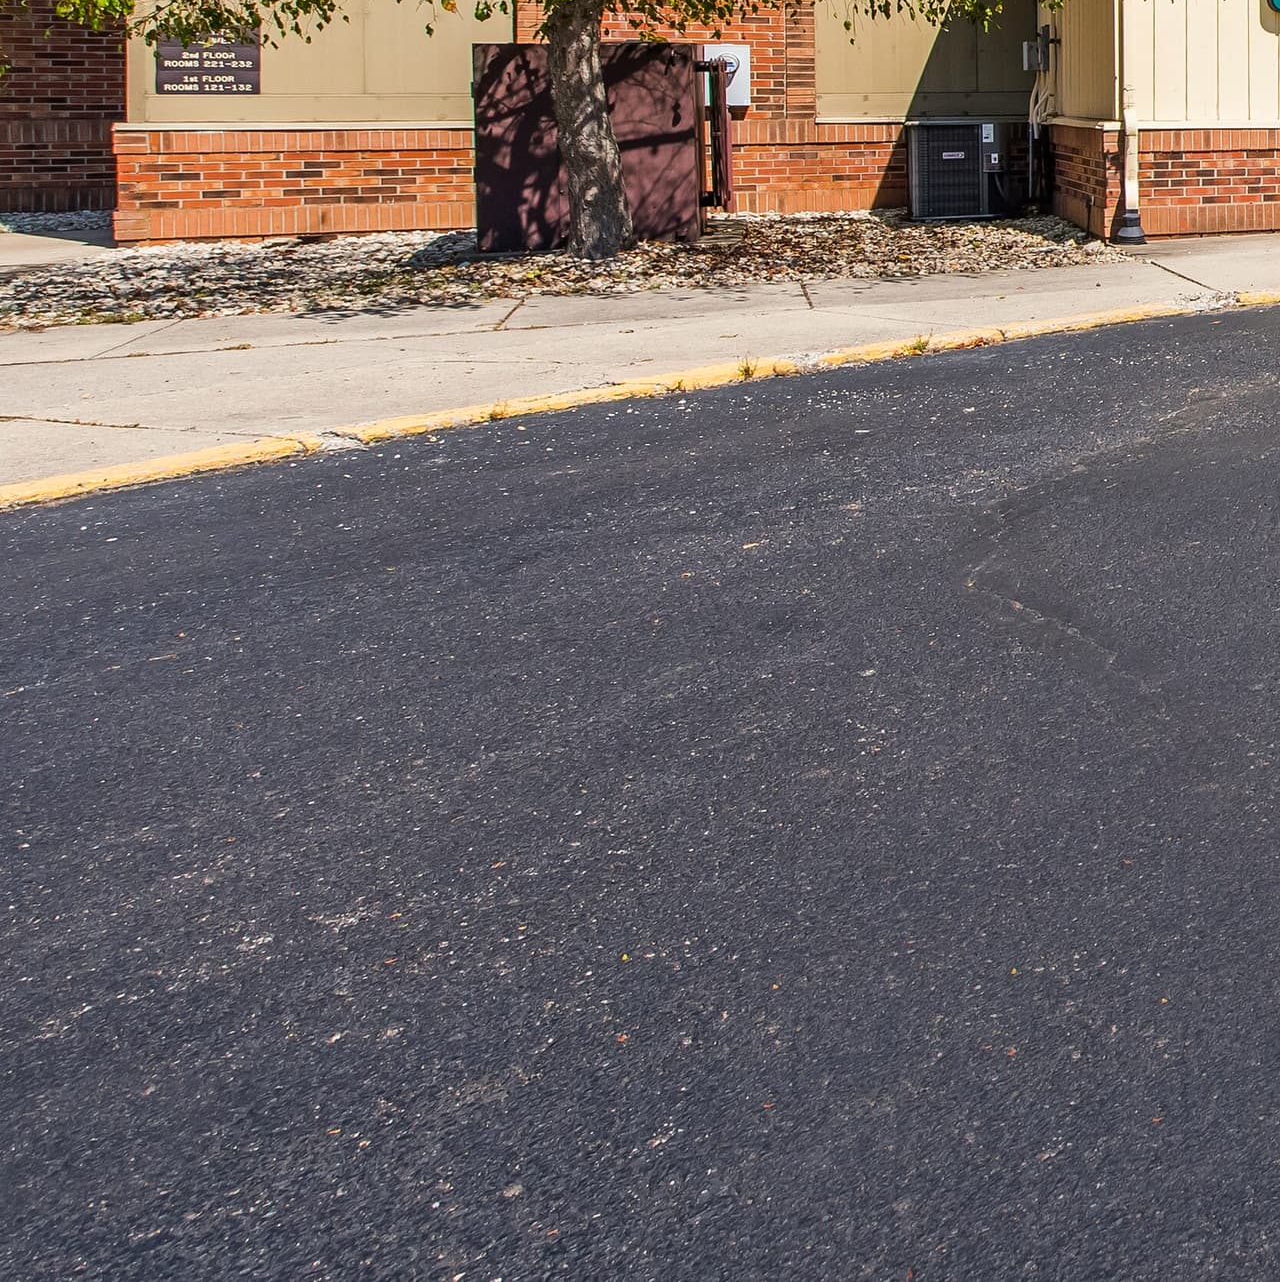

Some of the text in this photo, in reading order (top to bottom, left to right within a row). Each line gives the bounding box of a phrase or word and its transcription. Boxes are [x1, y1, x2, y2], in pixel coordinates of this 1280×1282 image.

[181, 51, 236, 59] 2nd FLOOR
[164, 60, 253, 68] ROOMS 221-232
